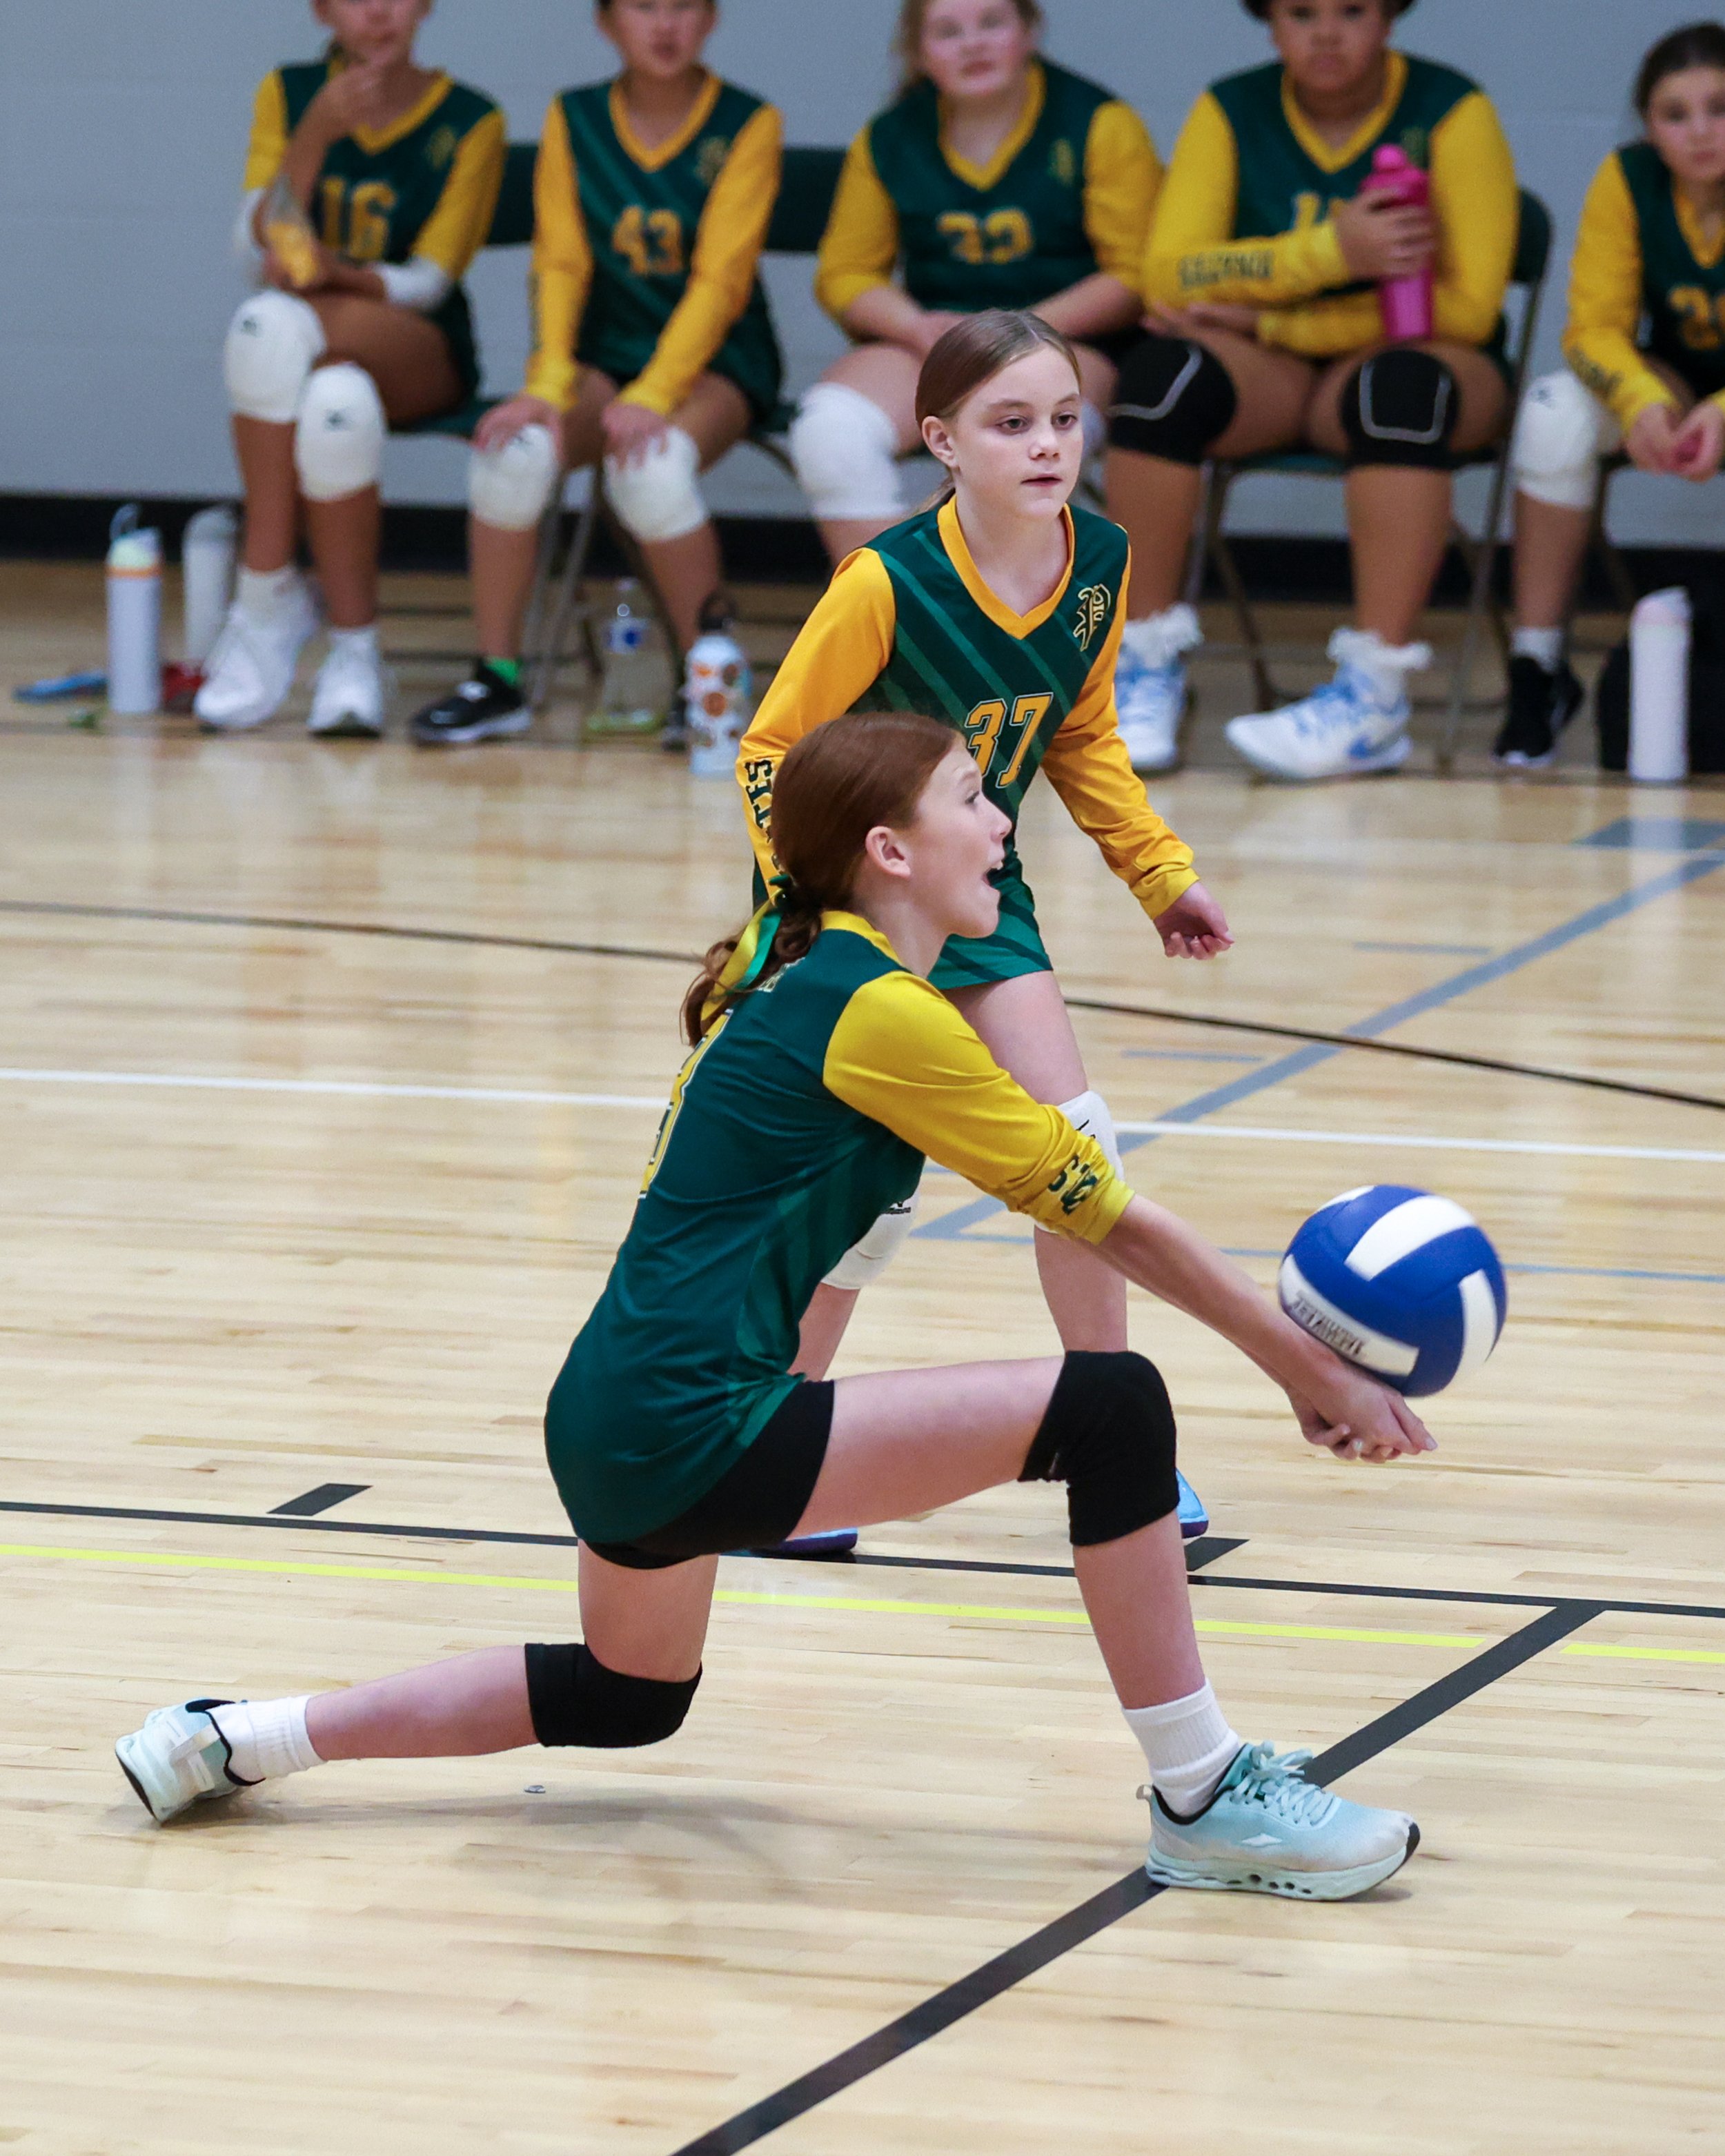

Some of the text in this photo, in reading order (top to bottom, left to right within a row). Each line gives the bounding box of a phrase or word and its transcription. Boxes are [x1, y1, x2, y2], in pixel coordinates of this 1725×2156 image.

[322, 177, 397, 259] 16
[611, 204, 683, 275] 43
[964, 692, 1054, 789] 37
